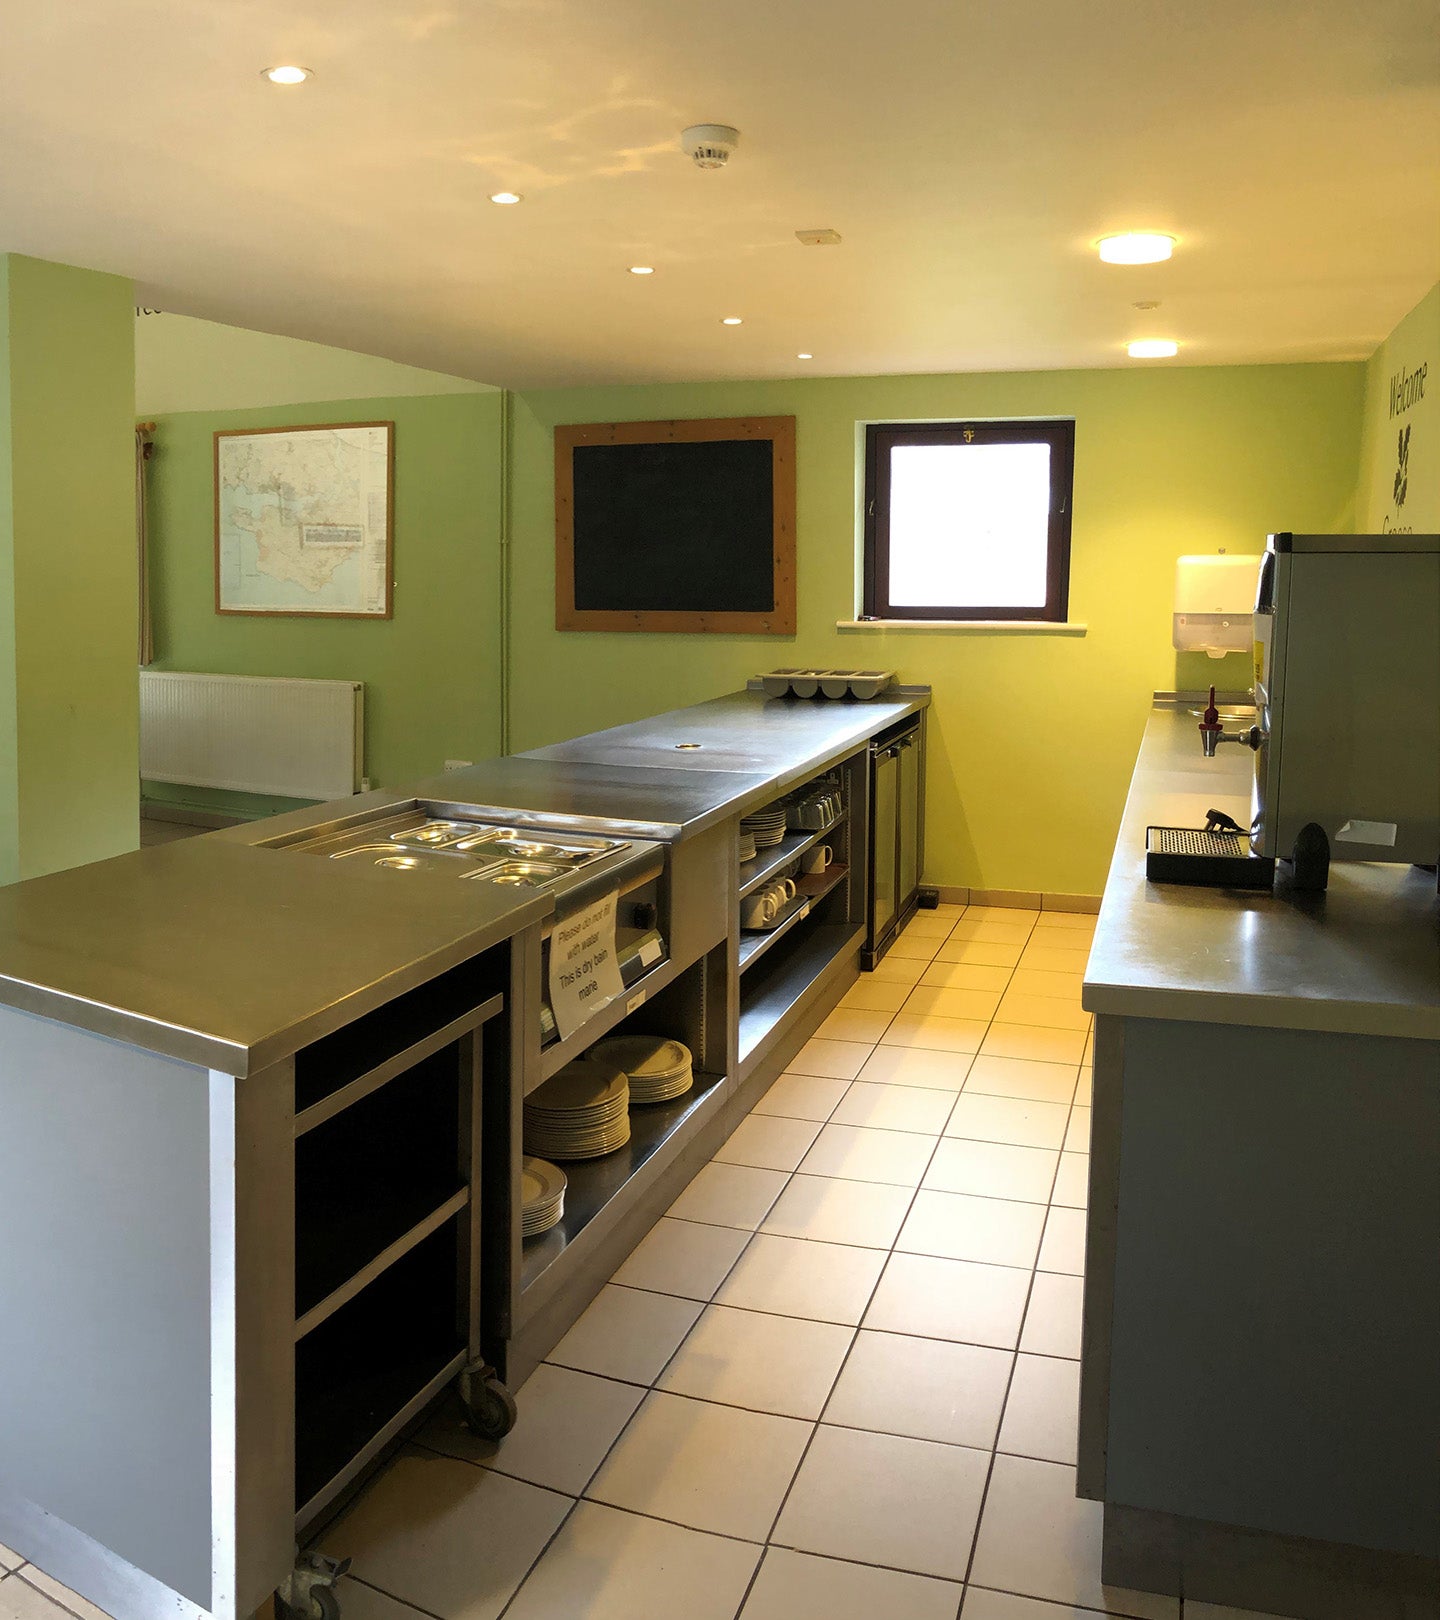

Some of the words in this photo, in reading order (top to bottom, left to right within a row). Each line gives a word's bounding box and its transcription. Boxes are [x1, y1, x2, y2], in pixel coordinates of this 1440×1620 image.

[1389, 361, 1428, 420] Welcome
[558, 923, 582, 945] Please
[582, 917, 592, 930] do
[592, 910, 603, 924] not
[567, 943, 580, 960] with
[581, 931, 600, 950] water
[559, 971, 576, 989] This
[575, 966, 582, 978] is
[582, 958, 593, 973] dry
[593, 948, 608, 966] bain
[578, 979, 598, 1000] marie
